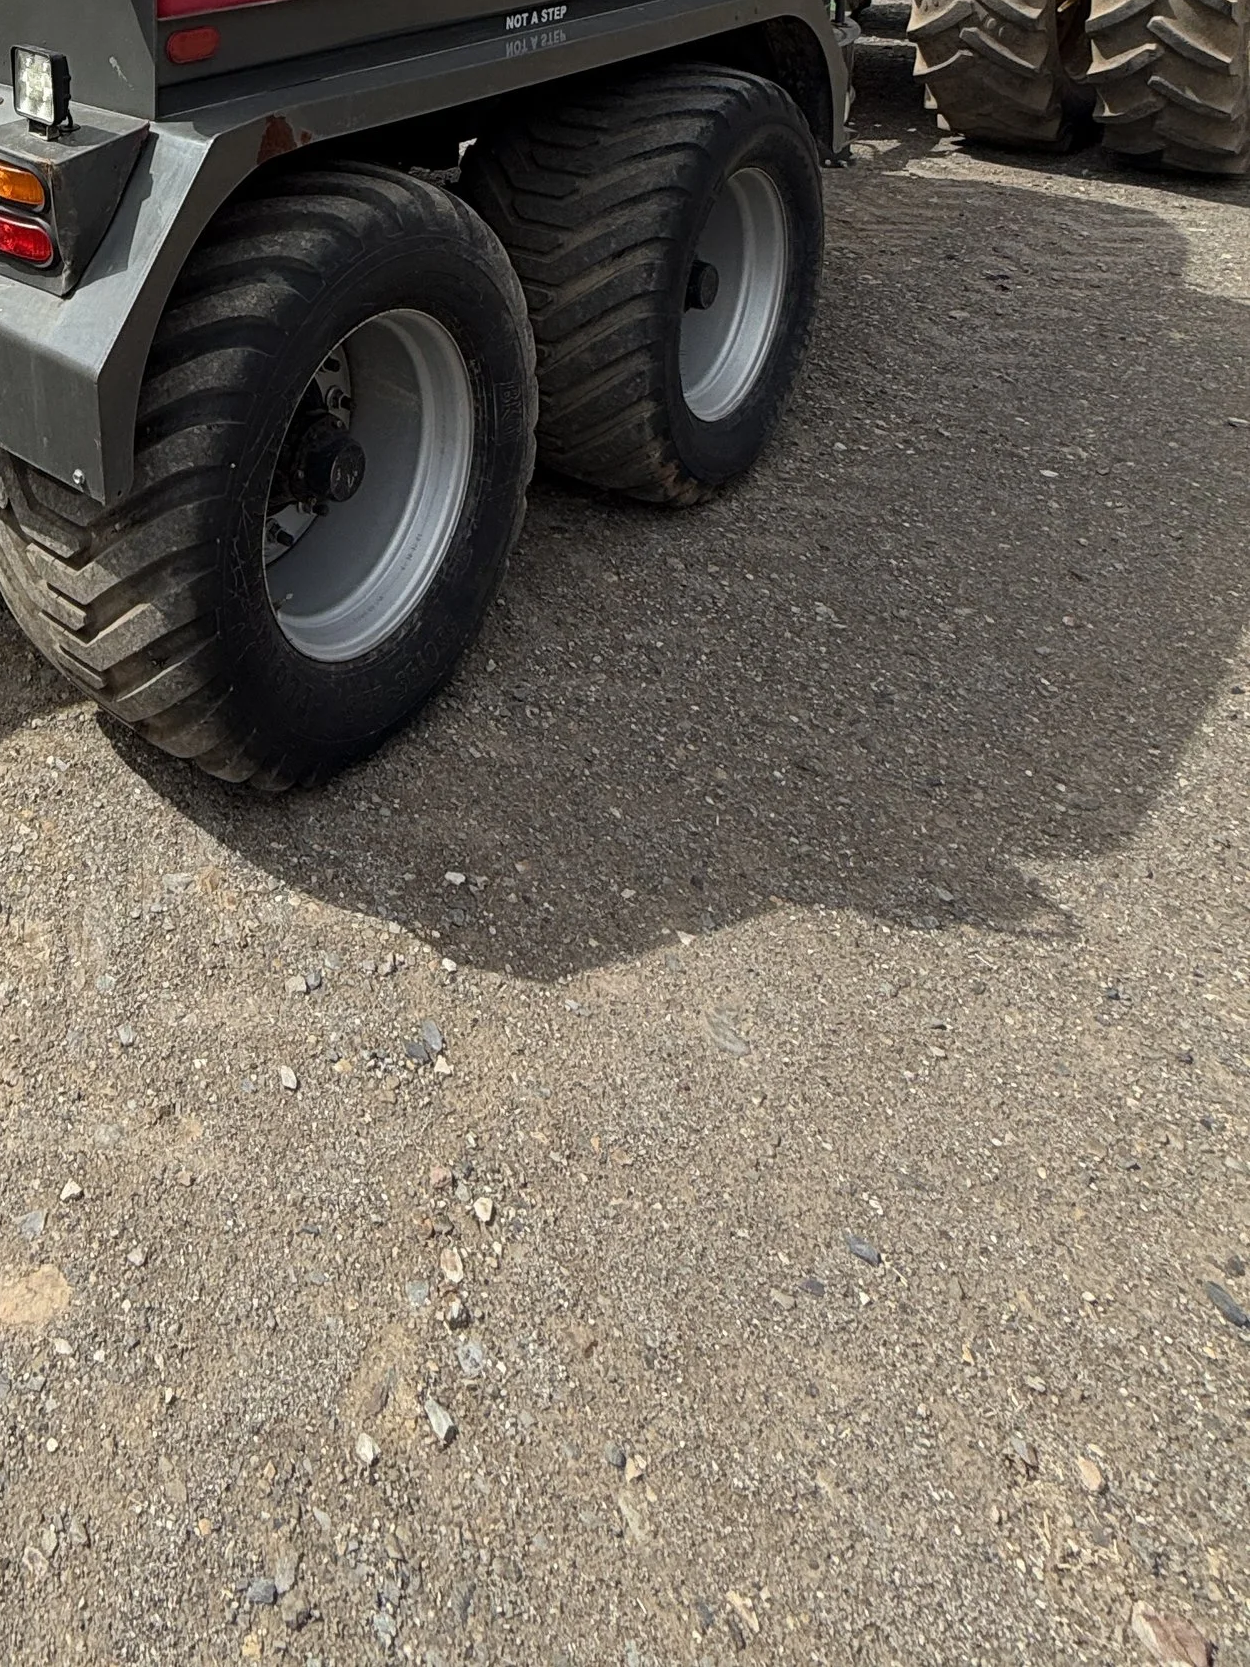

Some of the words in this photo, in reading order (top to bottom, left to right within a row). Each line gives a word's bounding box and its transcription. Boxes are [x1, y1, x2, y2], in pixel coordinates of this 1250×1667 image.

[506, 12, 529, 30] NOT
[530, 10, 539, 25] A
[541, 5, 567, 23] STEP
